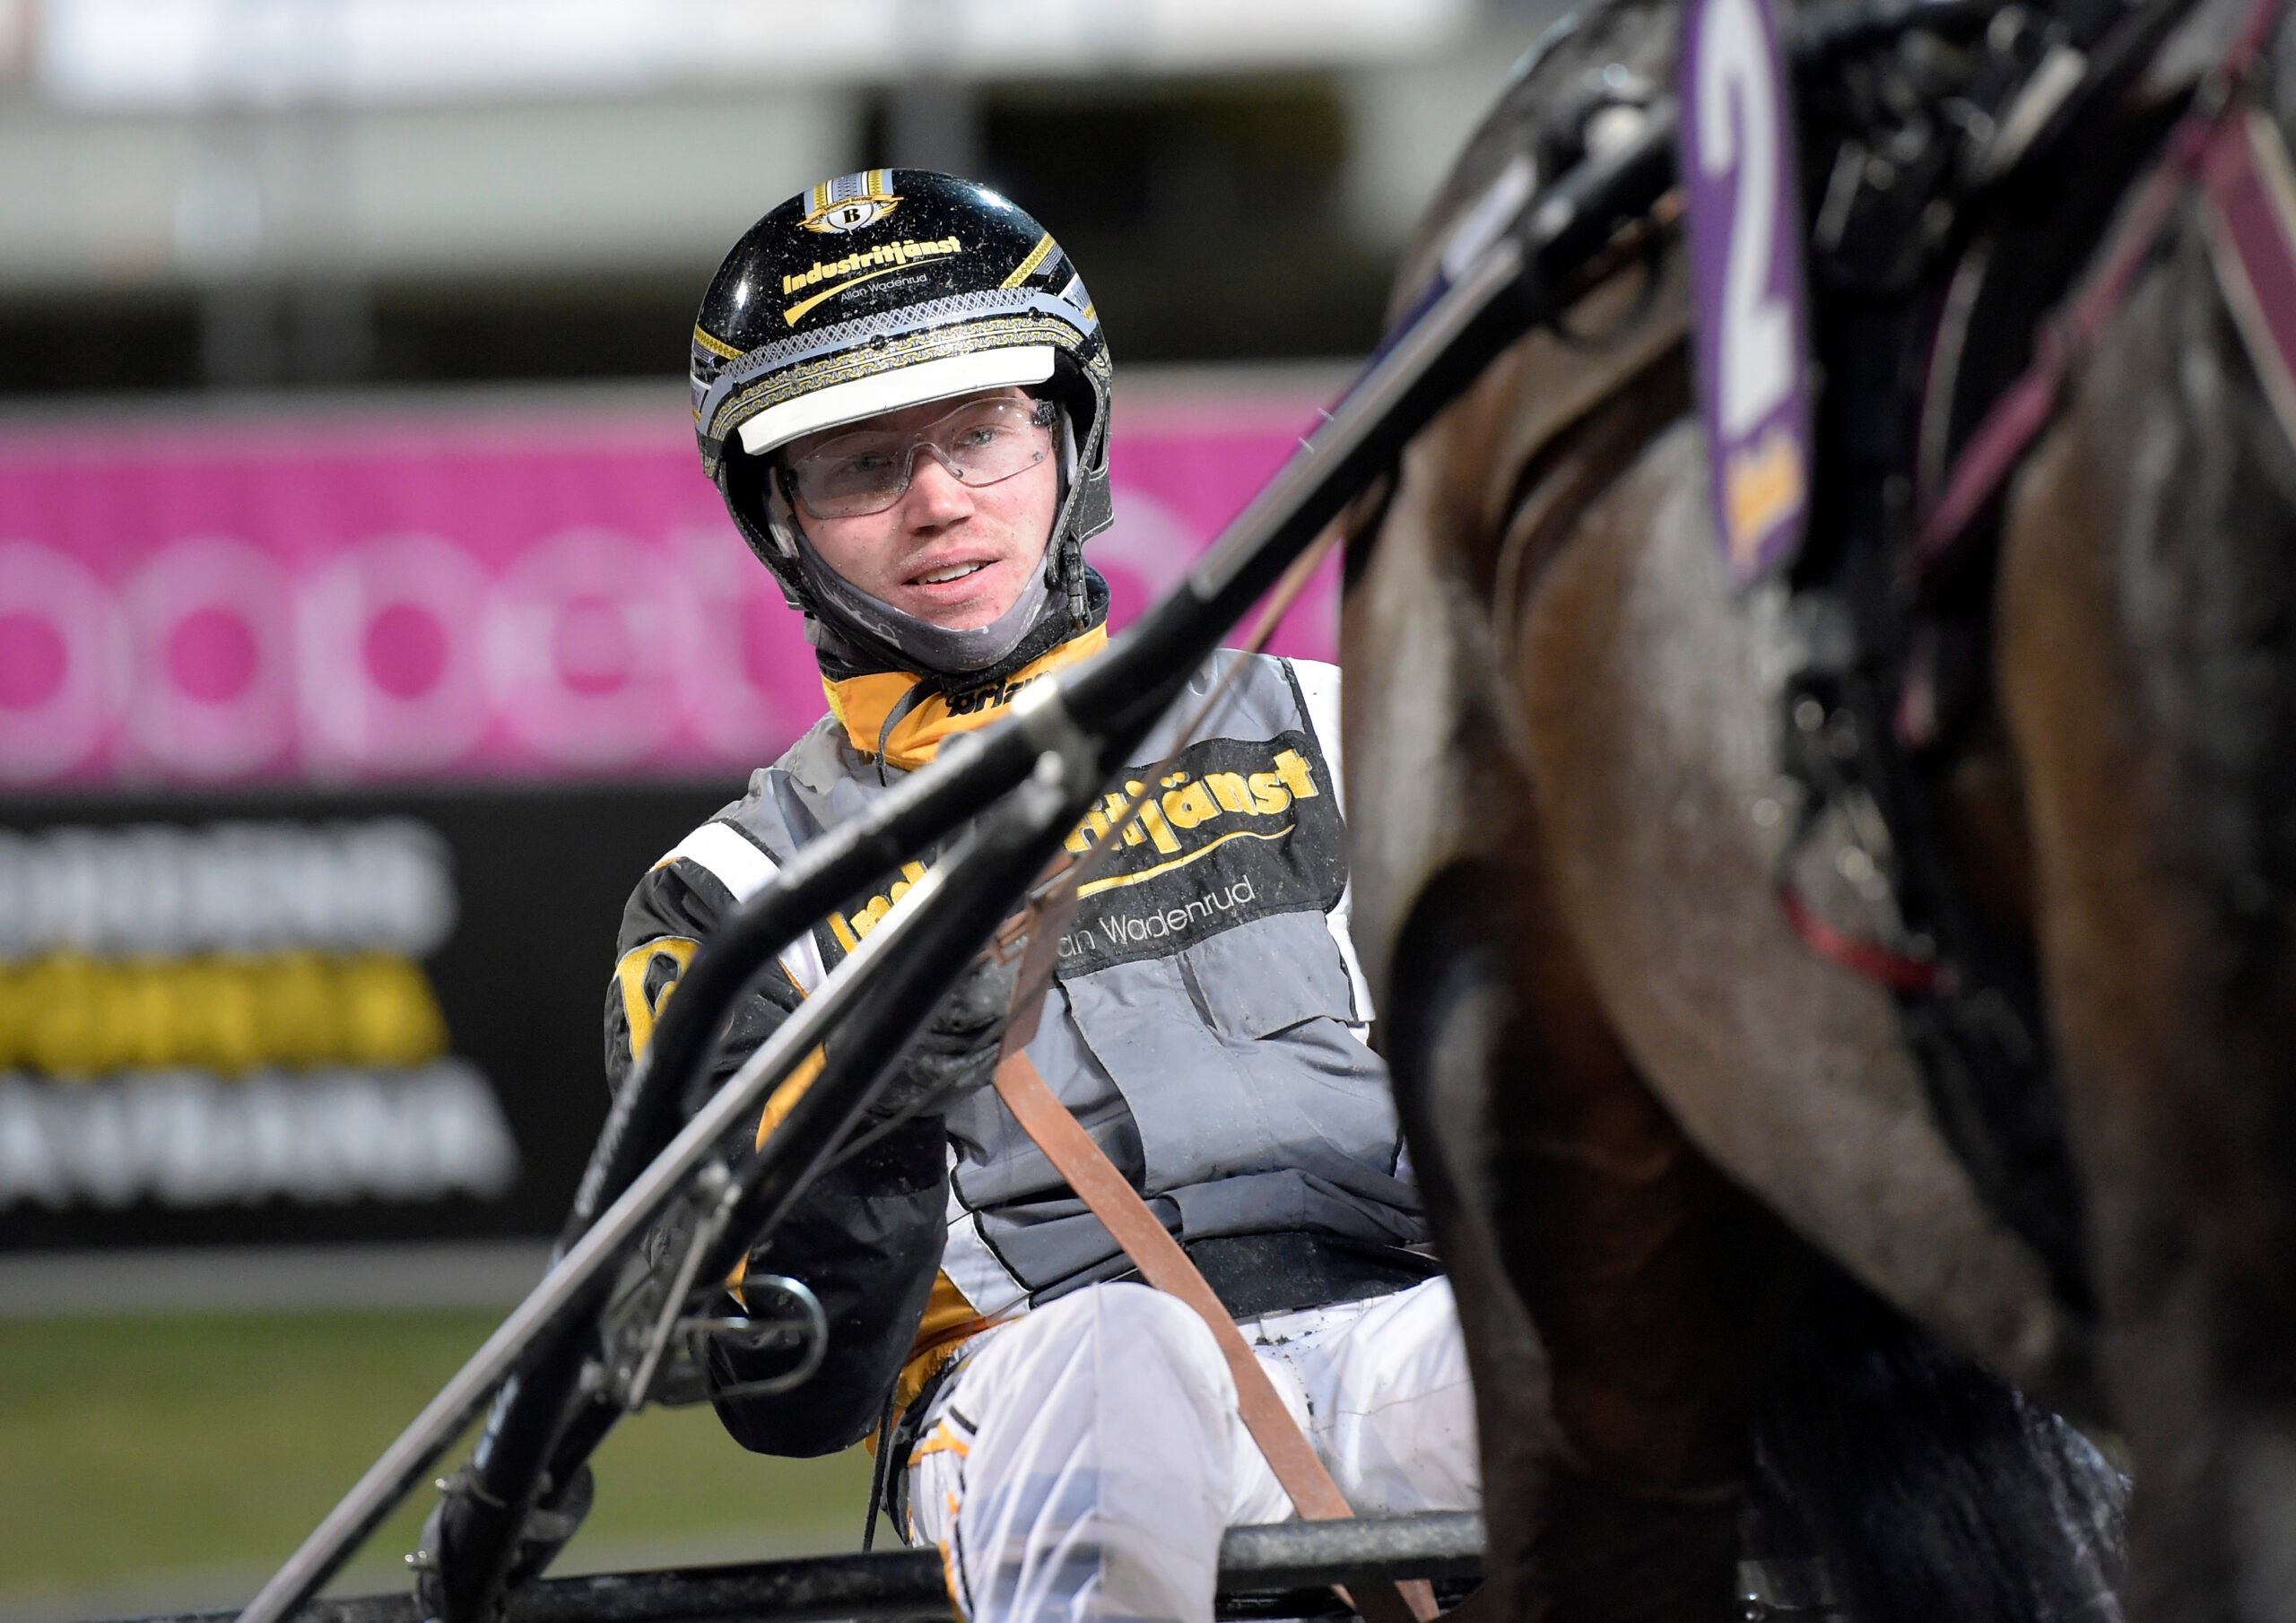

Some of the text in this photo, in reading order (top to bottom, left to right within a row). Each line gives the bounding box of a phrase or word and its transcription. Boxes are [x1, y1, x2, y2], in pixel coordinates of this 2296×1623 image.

[843, 208, 861, 224] B
[1698, 0, 1793, 442] 2
[783, 236, 962, 295] Industritjänst
[840, 273, 927, 302] Allan Wadenrud
[1099, 874, 1256, 945] Wadenrud
